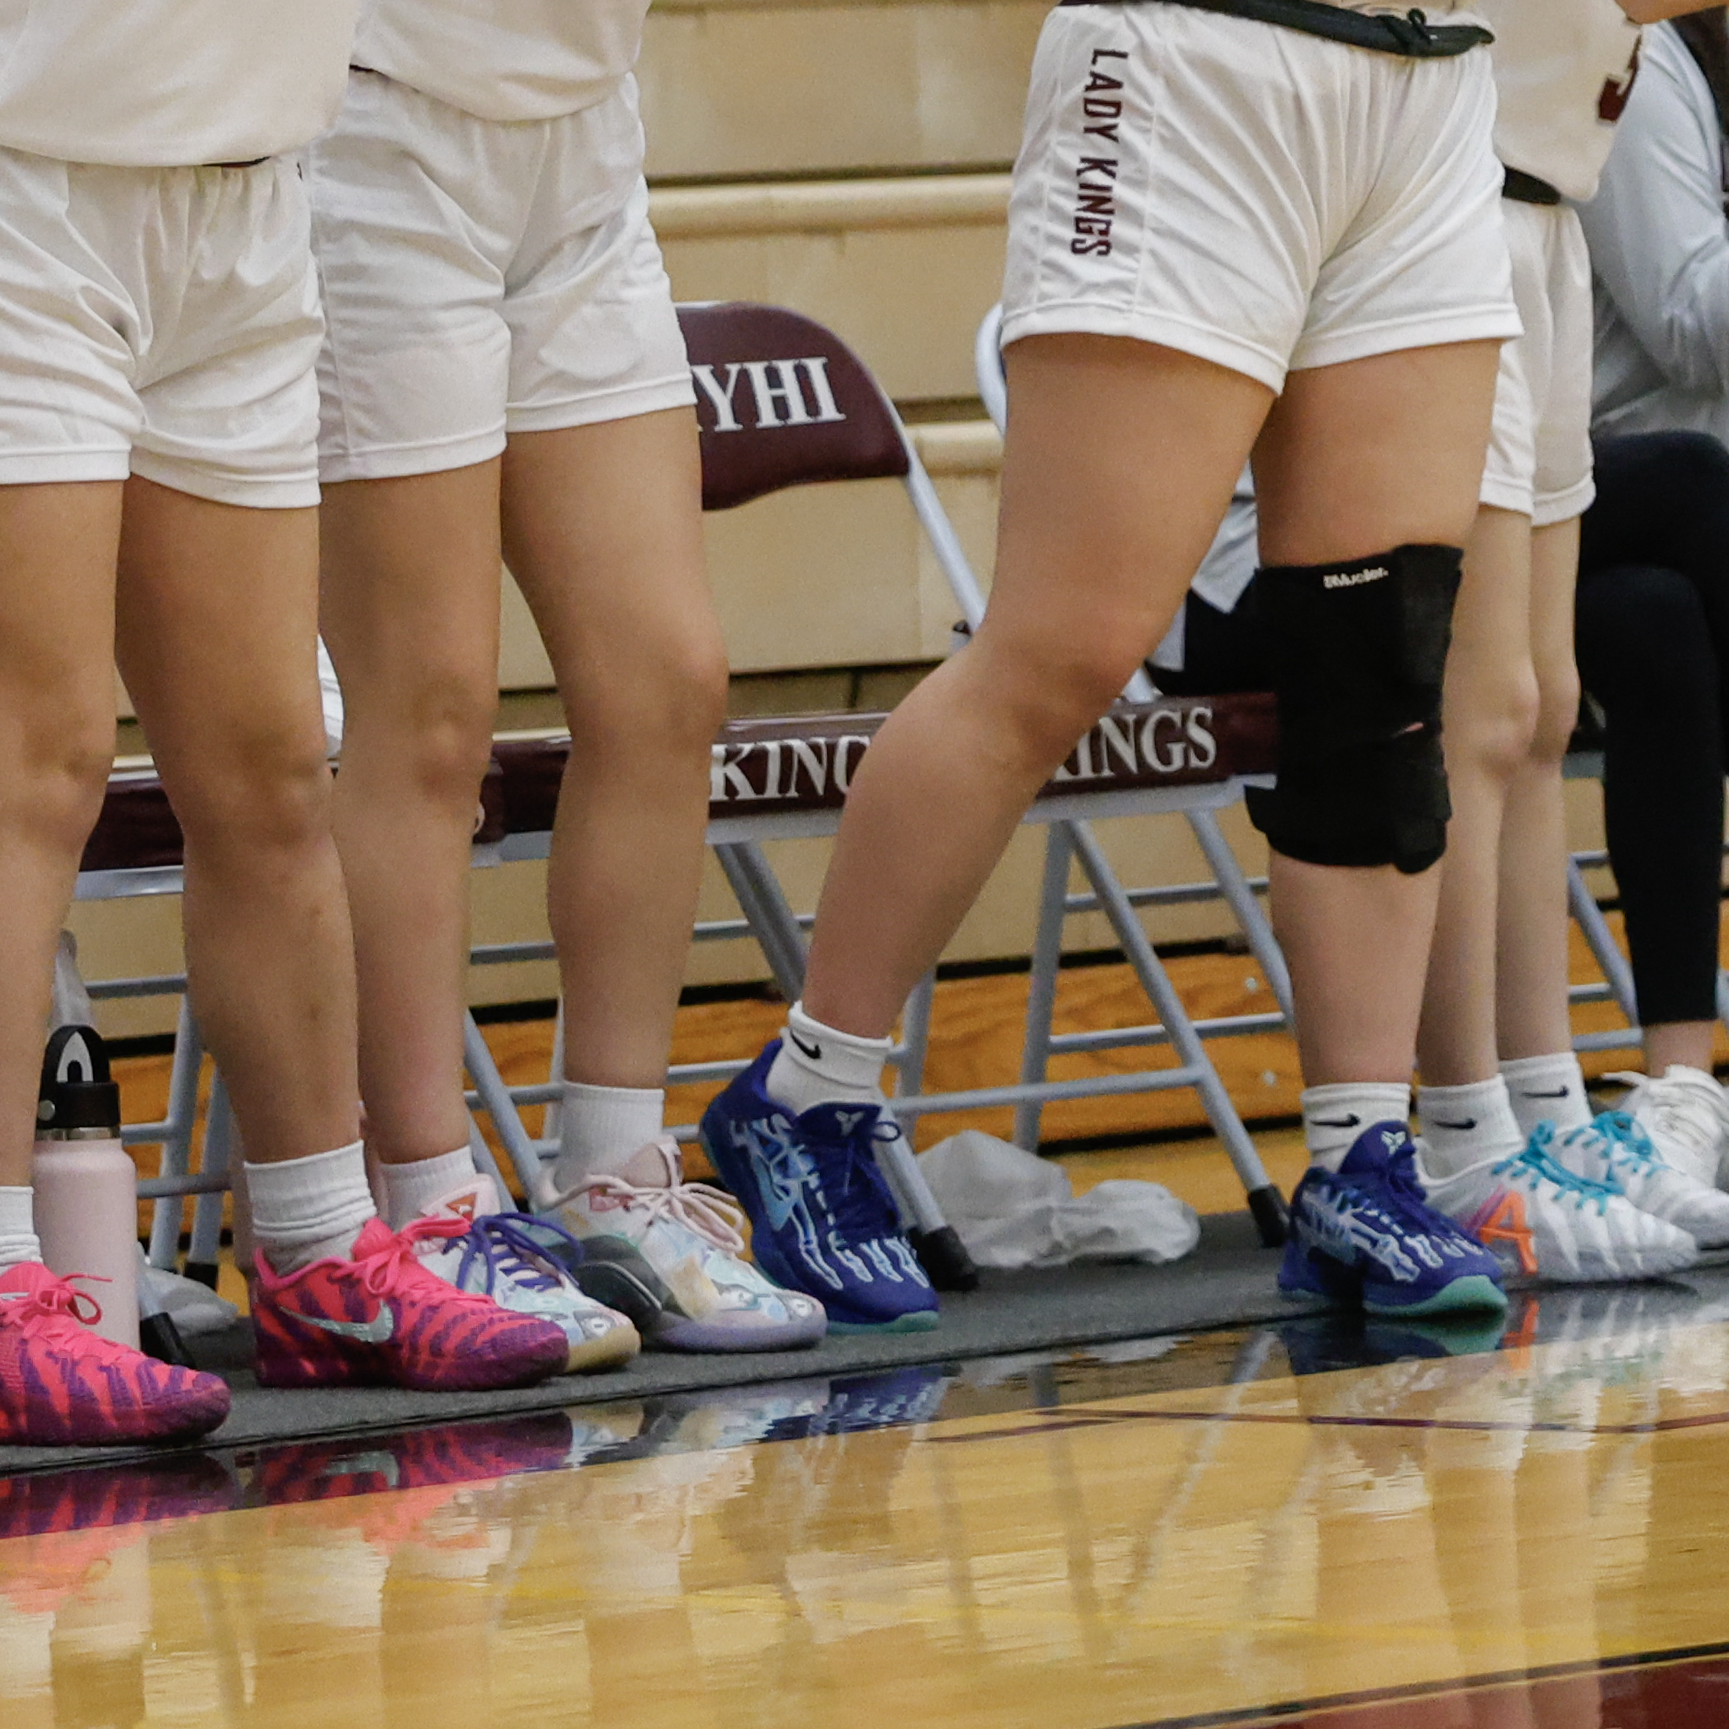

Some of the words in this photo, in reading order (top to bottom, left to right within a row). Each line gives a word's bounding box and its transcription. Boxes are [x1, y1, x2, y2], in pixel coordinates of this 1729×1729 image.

[1082, 49, 1129, 144] LADY
[1071, 156, 1118, 256] KINGS
[691, 355, 847, 432] YHI
[1050, 706, 1217, 783] INGS
